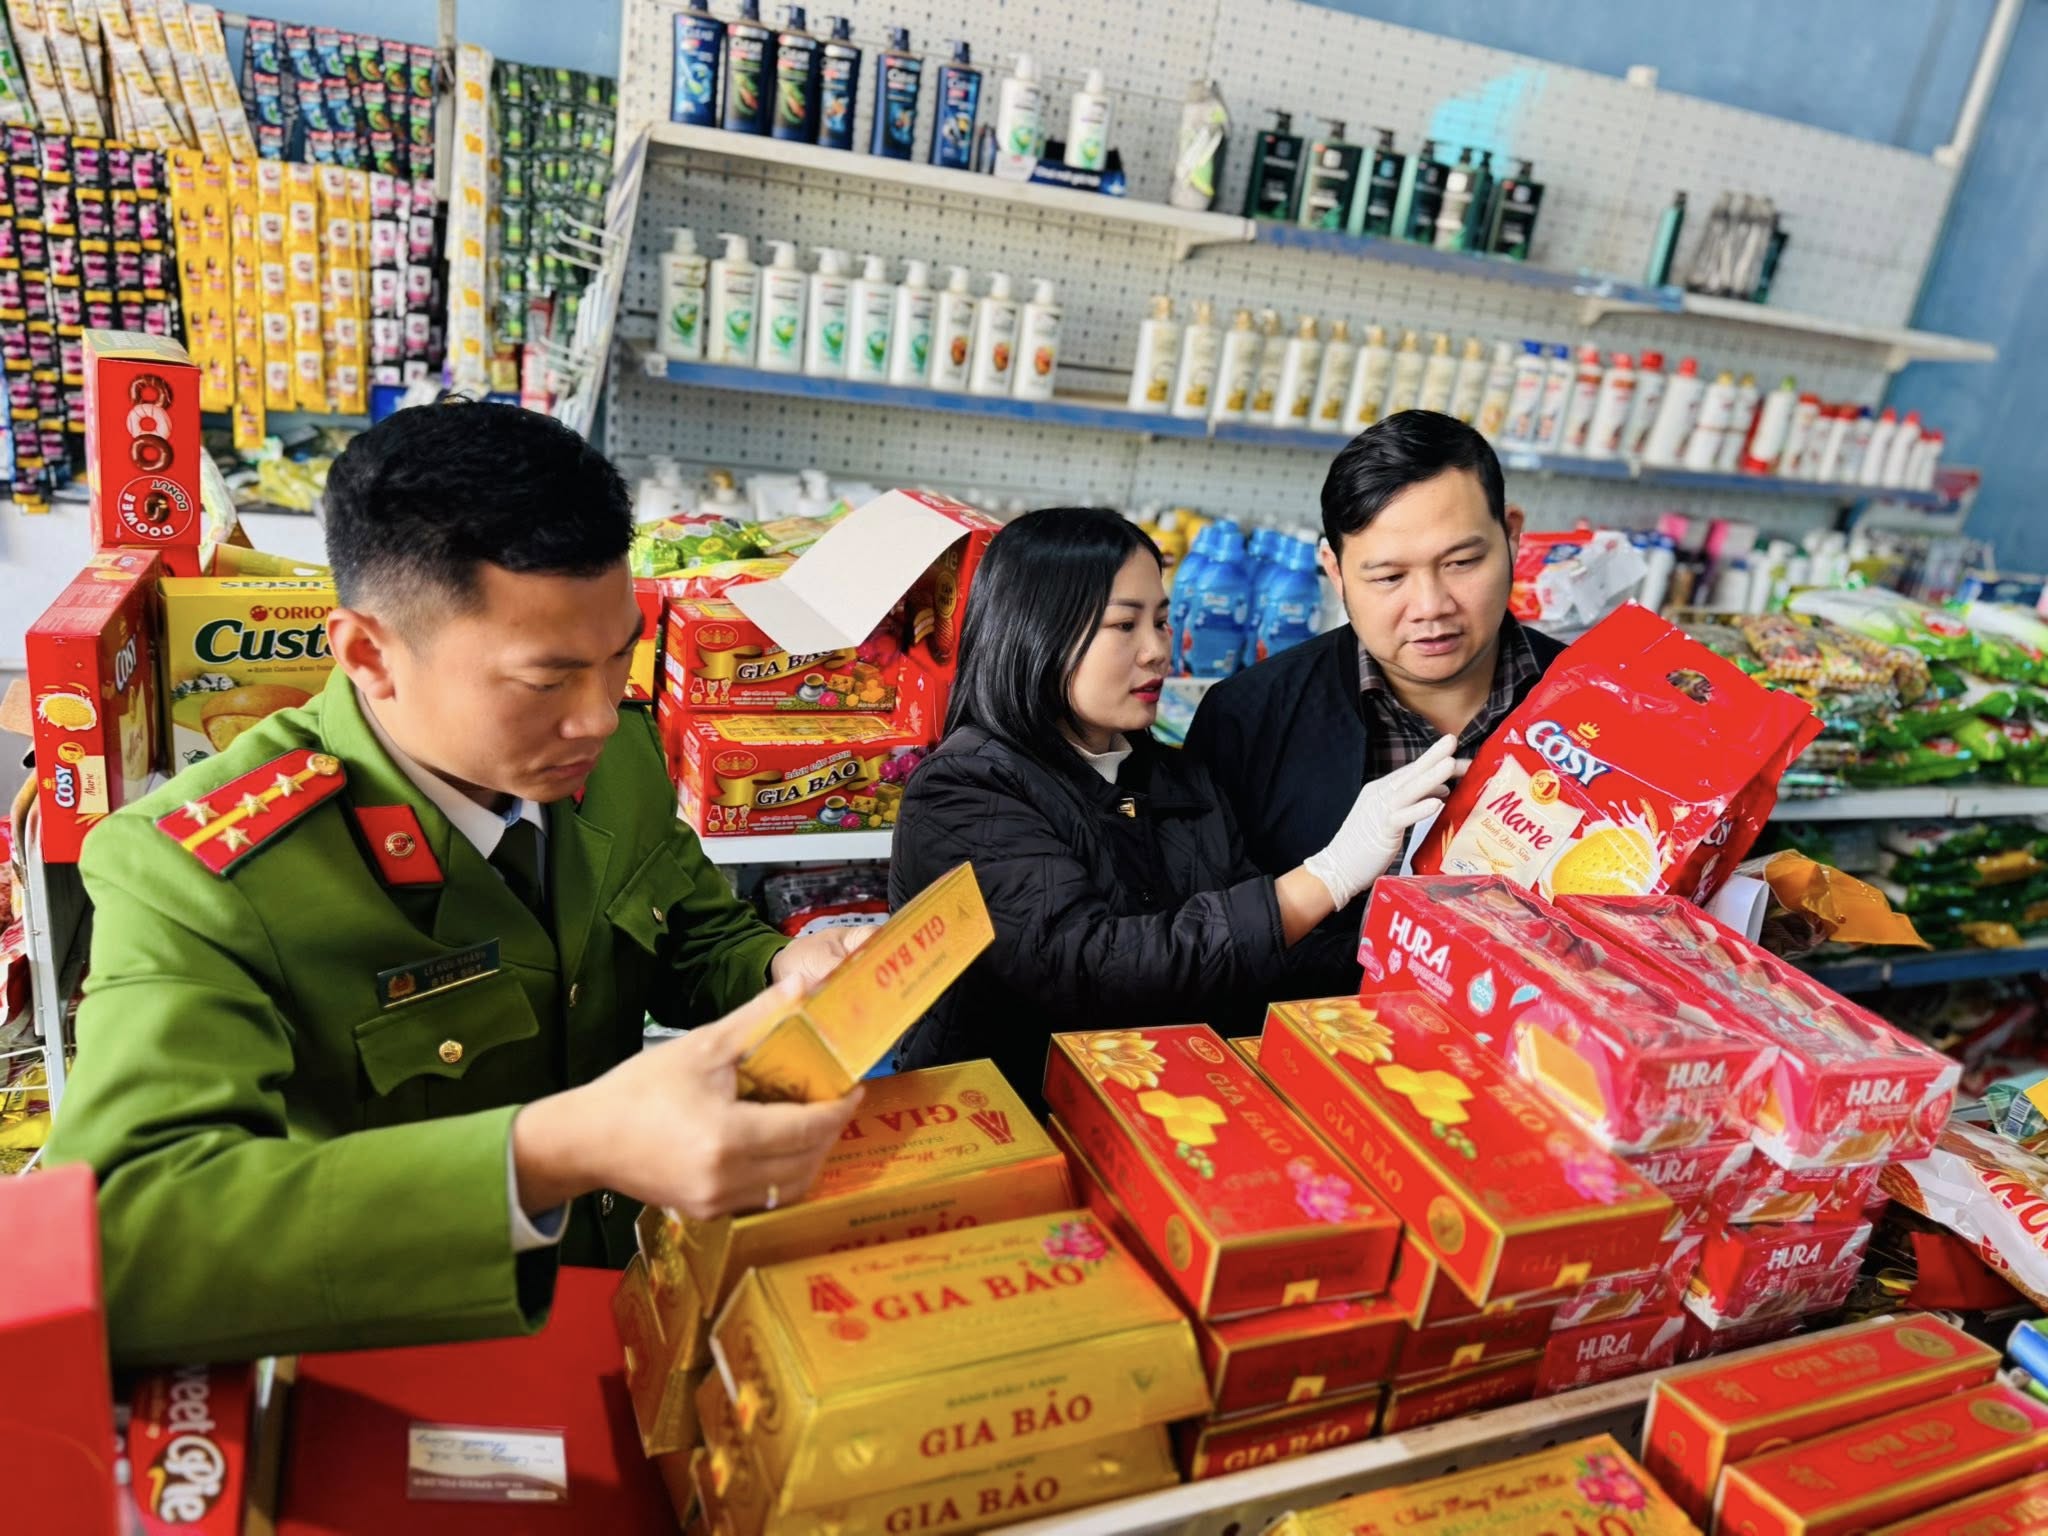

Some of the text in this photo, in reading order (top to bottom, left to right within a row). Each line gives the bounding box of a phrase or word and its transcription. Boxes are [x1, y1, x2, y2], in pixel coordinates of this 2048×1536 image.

[121, 492, 174, 537] DOOWEE
[151, 479, 189, 512] DONUT
[738, 659, 781, 680] GIA
[1525, 719, 1611, 789] COSY
[54, 763, 76, 808] COSY
[756, 760, 860, 805] GIA BẢO
[1486, 790, 1553, 851] Marie
[912, 914, 945, 952] GIA
[1388, 910, 1451, 974] HURA
[1206, 1072, 1246, 1106] GIA
[1664, 1060, 1726, 1090] HURA
[1845, 1078, 1906, 1106] HURA
[874, 1103, 959, 1132] GIA
[1324, 1101, 1356, 1144] GIA
[1767, 1242, 1823, 1271] HURA
[871, 1286, 974, 1322] GIA
[982, 1260, 1086, 1302] BẢO
[1577, 1332, 1631, 1362] HURA
[919, 1389, 1094, 1458] GIA BẢO
[1223, 1442, 1278, 1471] GIA
[884, 1470, 1060, 1535] GIA BẢO
